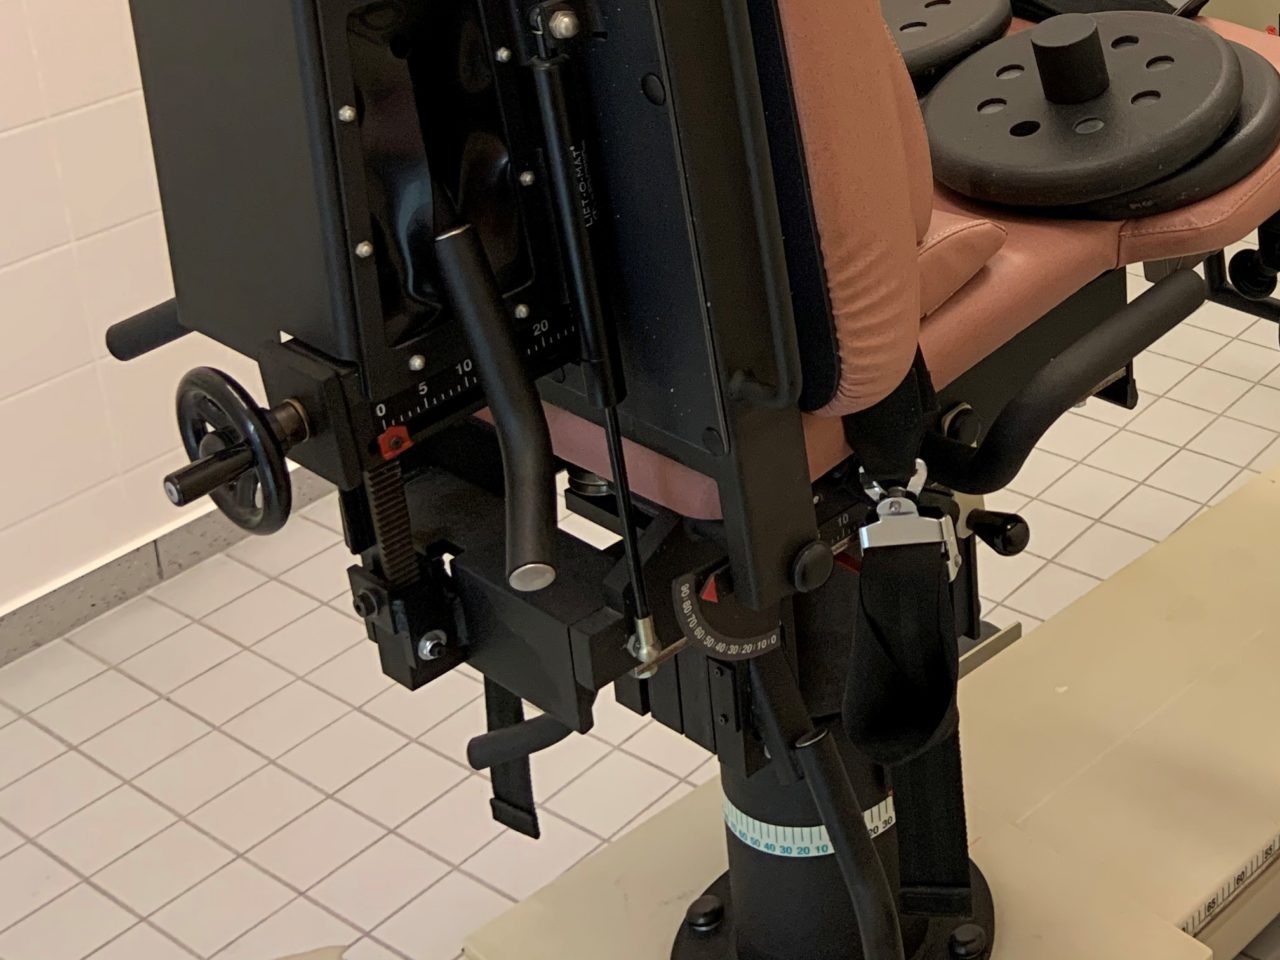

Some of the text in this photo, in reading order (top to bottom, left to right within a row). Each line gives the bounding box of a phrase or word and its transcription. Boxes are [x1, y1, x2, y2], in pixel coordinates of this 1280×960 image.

[375, 319, 550, 417] 0 5 10 20
[681, 583, 777, 654] 90 80 70 60 50 40 30 20 10 0
[763, 842, 776, 852] 40
[779, 845, 793, 855] 30
[796, 846, 810, 855] 20
[815, 844, 829, 853] 10
[882, 816, 893, 829] 30
